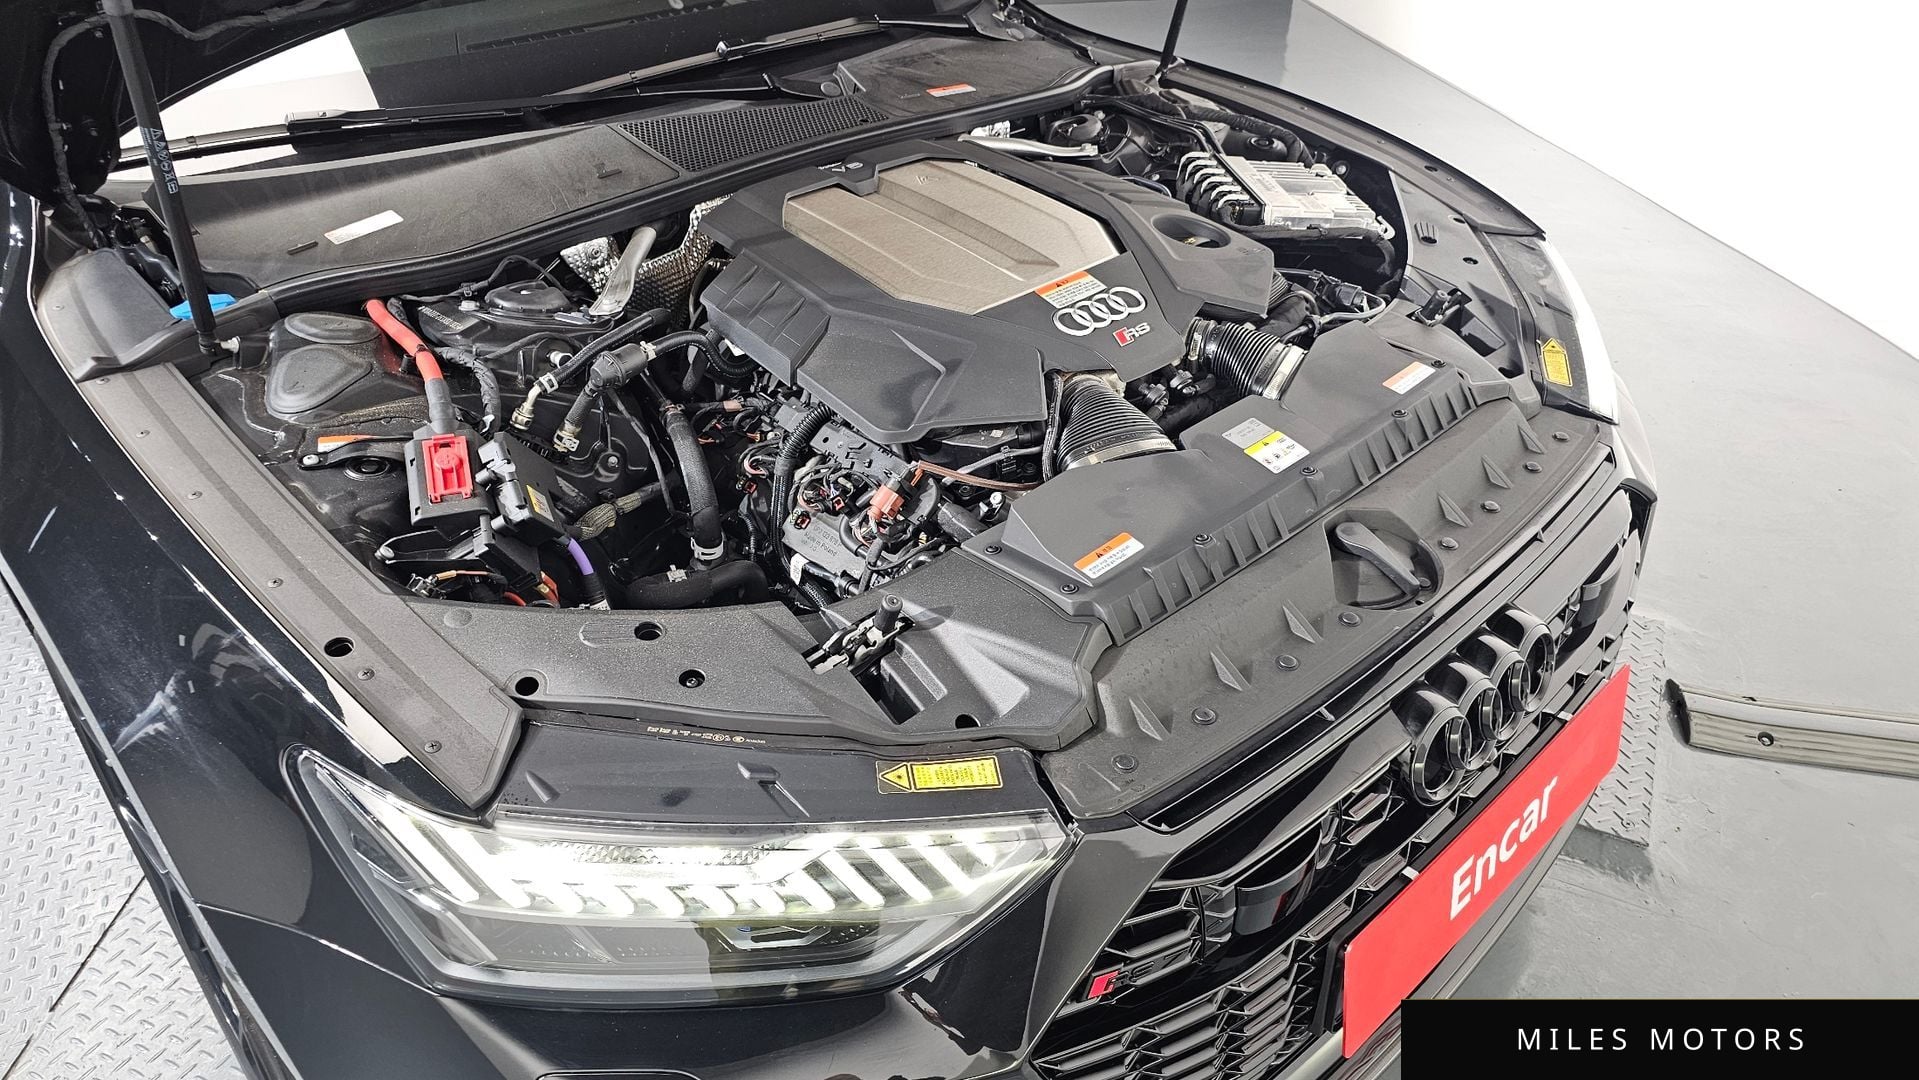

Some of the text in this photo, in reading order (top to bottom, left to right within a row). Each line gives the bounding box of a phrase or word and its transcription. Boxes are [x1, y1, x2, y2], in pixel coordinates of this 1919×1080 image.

[1116, 322, 1151, 345] RS
[820, 542, 839, 557] Poland
[1449, 775, 1559, 921] Encar
